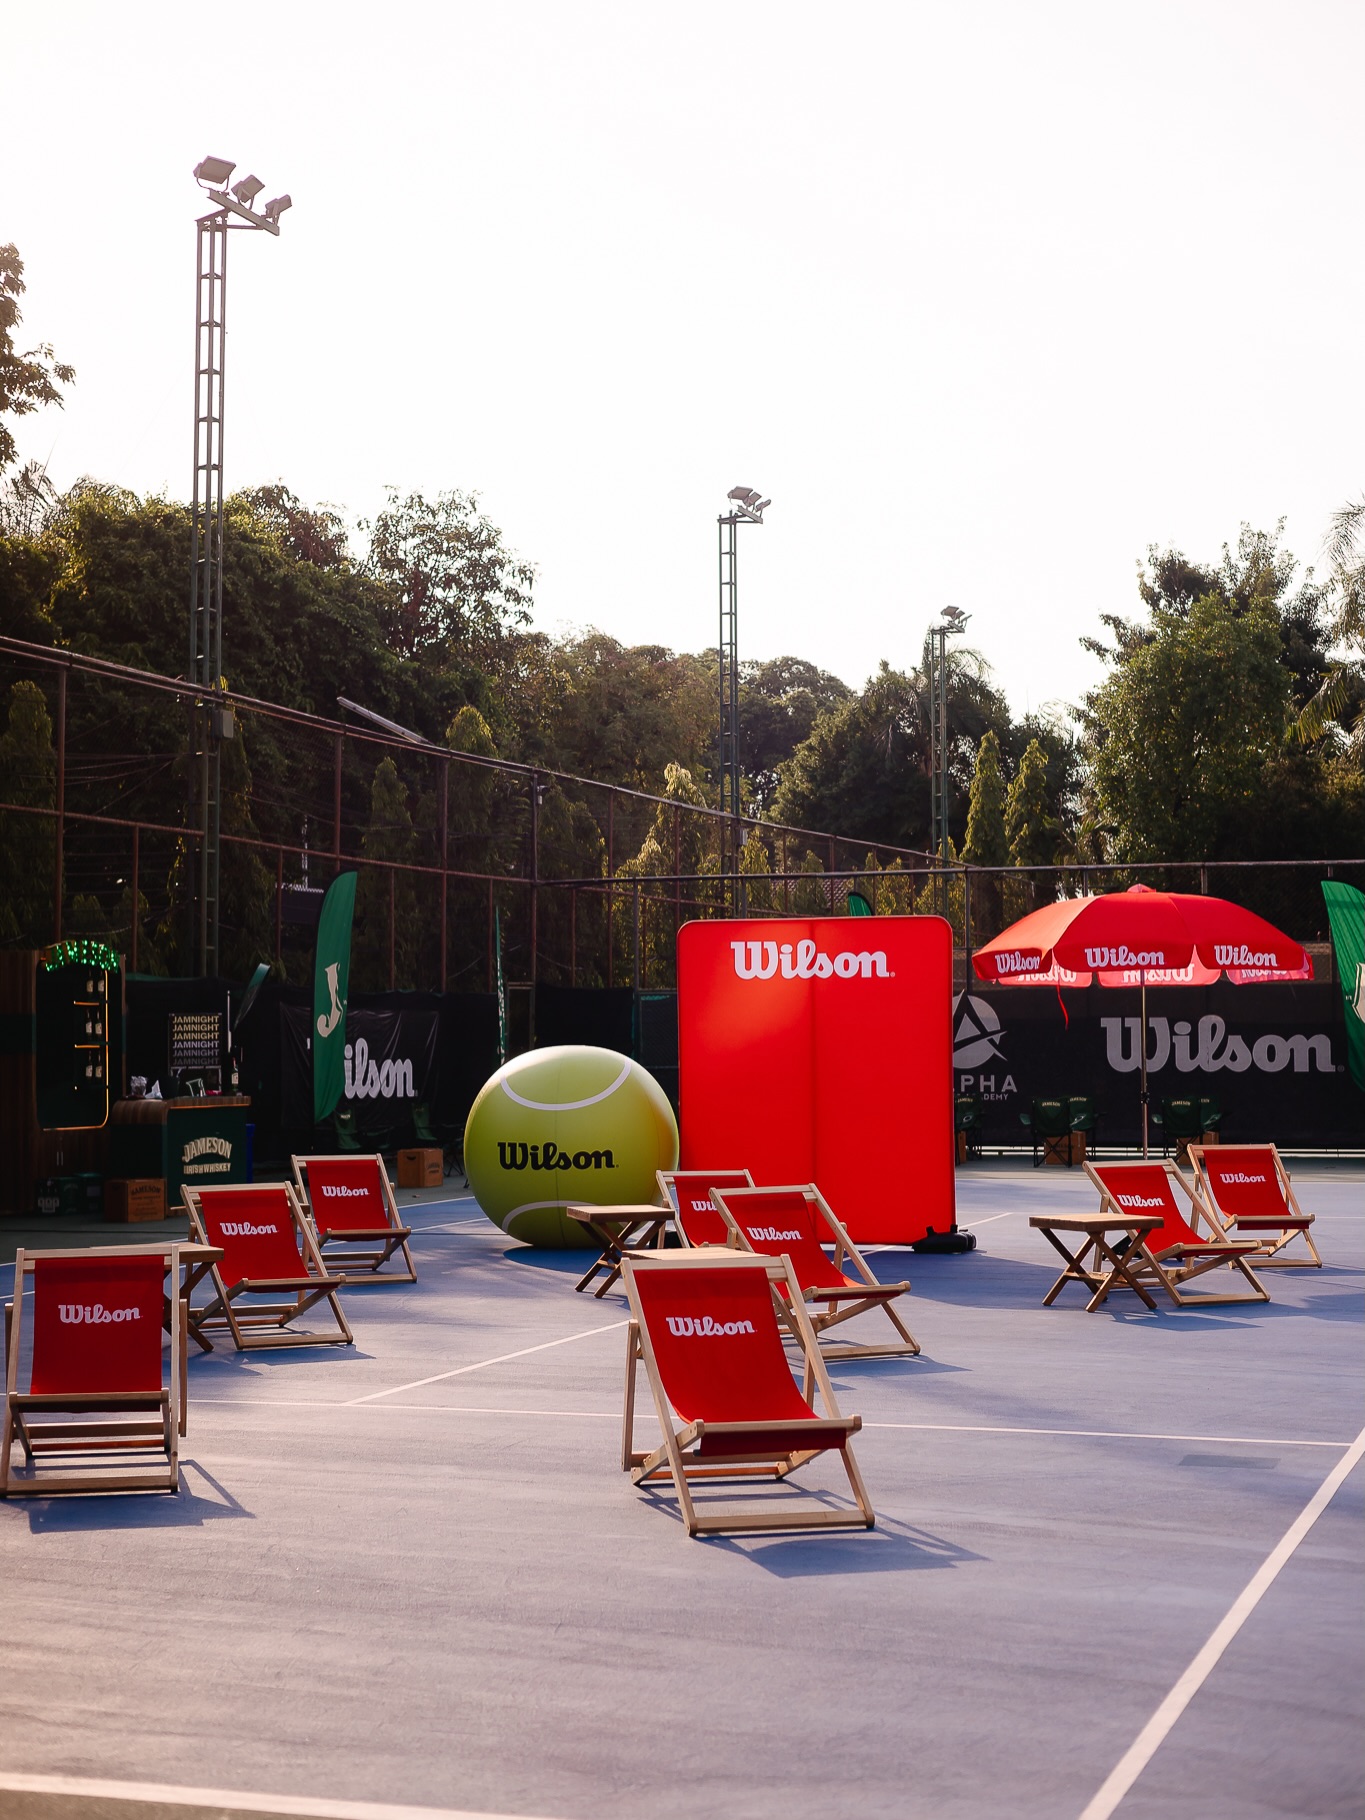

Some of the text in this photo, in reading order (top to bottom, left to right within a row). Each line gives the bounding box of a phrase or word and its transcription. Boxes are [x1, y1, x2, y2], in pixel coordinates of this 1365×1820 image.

[731, 939, 892, 980] Wilson
[995, 951, 1041, 974] Wilson
[1085, 945, 1164, 968] Wilson
[1213, 945, 1277, 967] Wilson
[173, 1032, 219, 1040] JAMNIGHT
[1100, 1015, 1336, 1072] Wilson
[173, 1049, 219, 1057] JAMNIGHT
[344, 1038, 414, 1098] ilson
[953, 1075, 1017, 1092] PHA
[182, 1137, 232, 1162] JAMESON
[497, 1142, 616, 1170] Wilson
[184, 1162, 231, 1174] IRISH WHISKEY
[1220, 1173, 1266, 1184] Wilson
[321, 1185, 369, 1197] Wilson
[1117, 1194, 1165, 1207] Wilson
[691, 1200, 717, 1211] Wil
[220, 1222, 278, 1236] Wilson
[747, 1227, 802, 1241] Wilson
[58, 1303, 141, 1324] Wilson
[666, 1316, 755, 1337] Wilson
